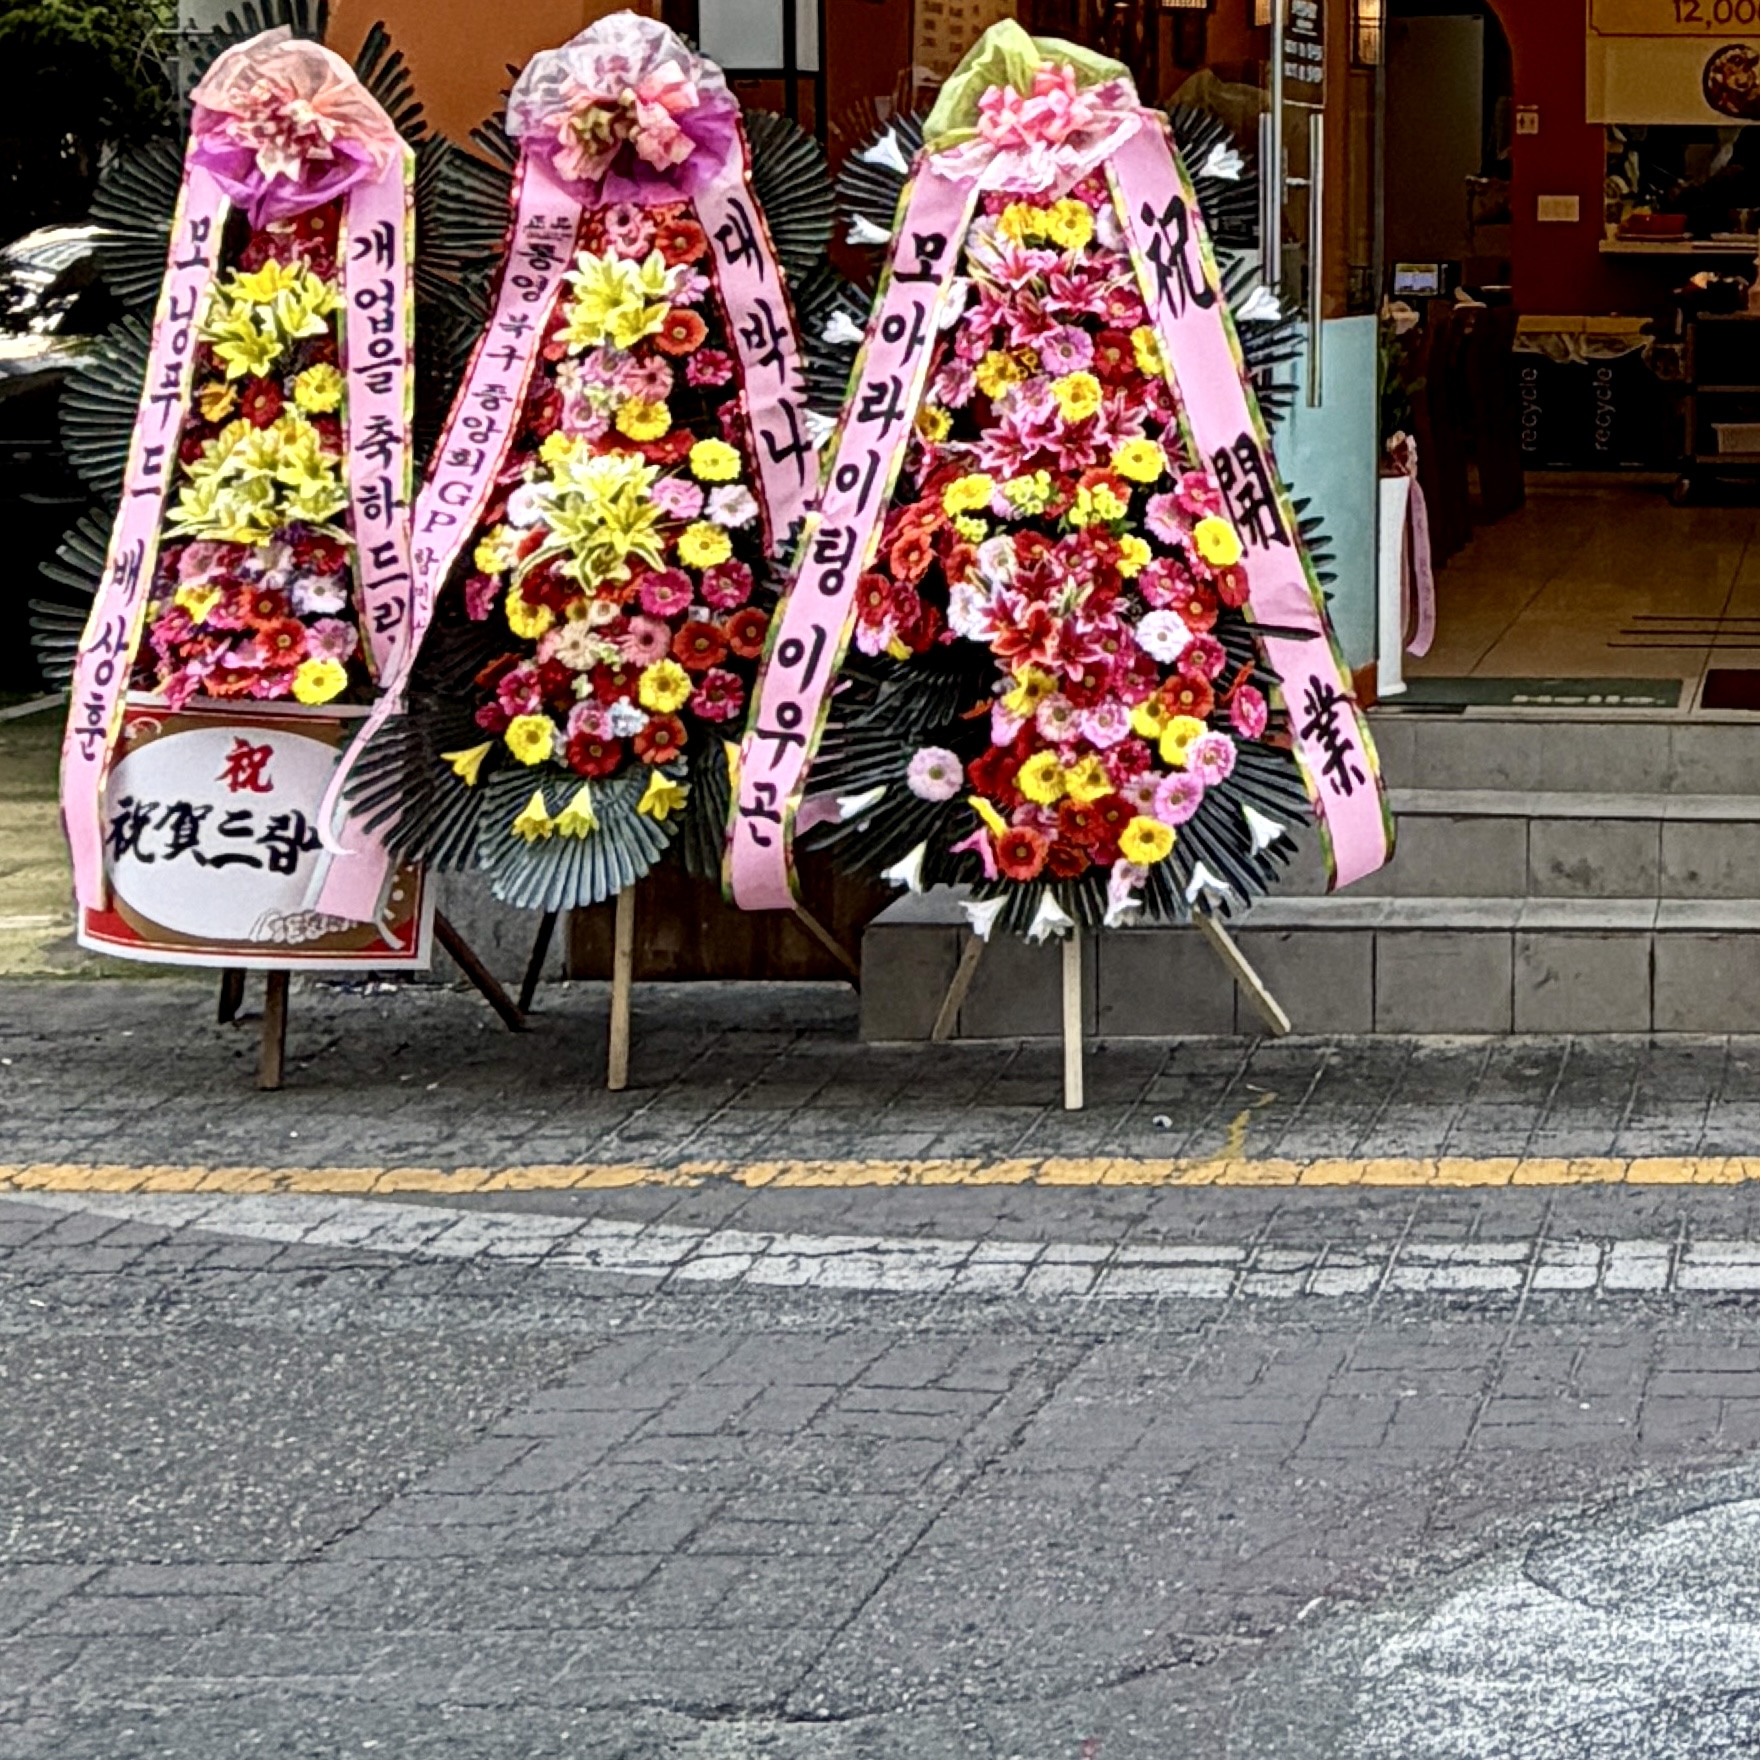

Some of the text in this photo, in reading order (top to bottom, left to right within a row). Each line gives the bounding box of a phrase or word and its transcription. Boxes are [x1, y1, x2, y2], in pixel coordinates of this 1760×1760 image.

[352, 220, 402, 394] 개업을
[810, 233, 946, 598] 모아라이팅
[1519, 366, 1543, 452] recycle
[1593, 366, 1617, 452] recycle
[215, 735, 275, 794] 祝
[106, 795, 323, 876] 祝賀드립
